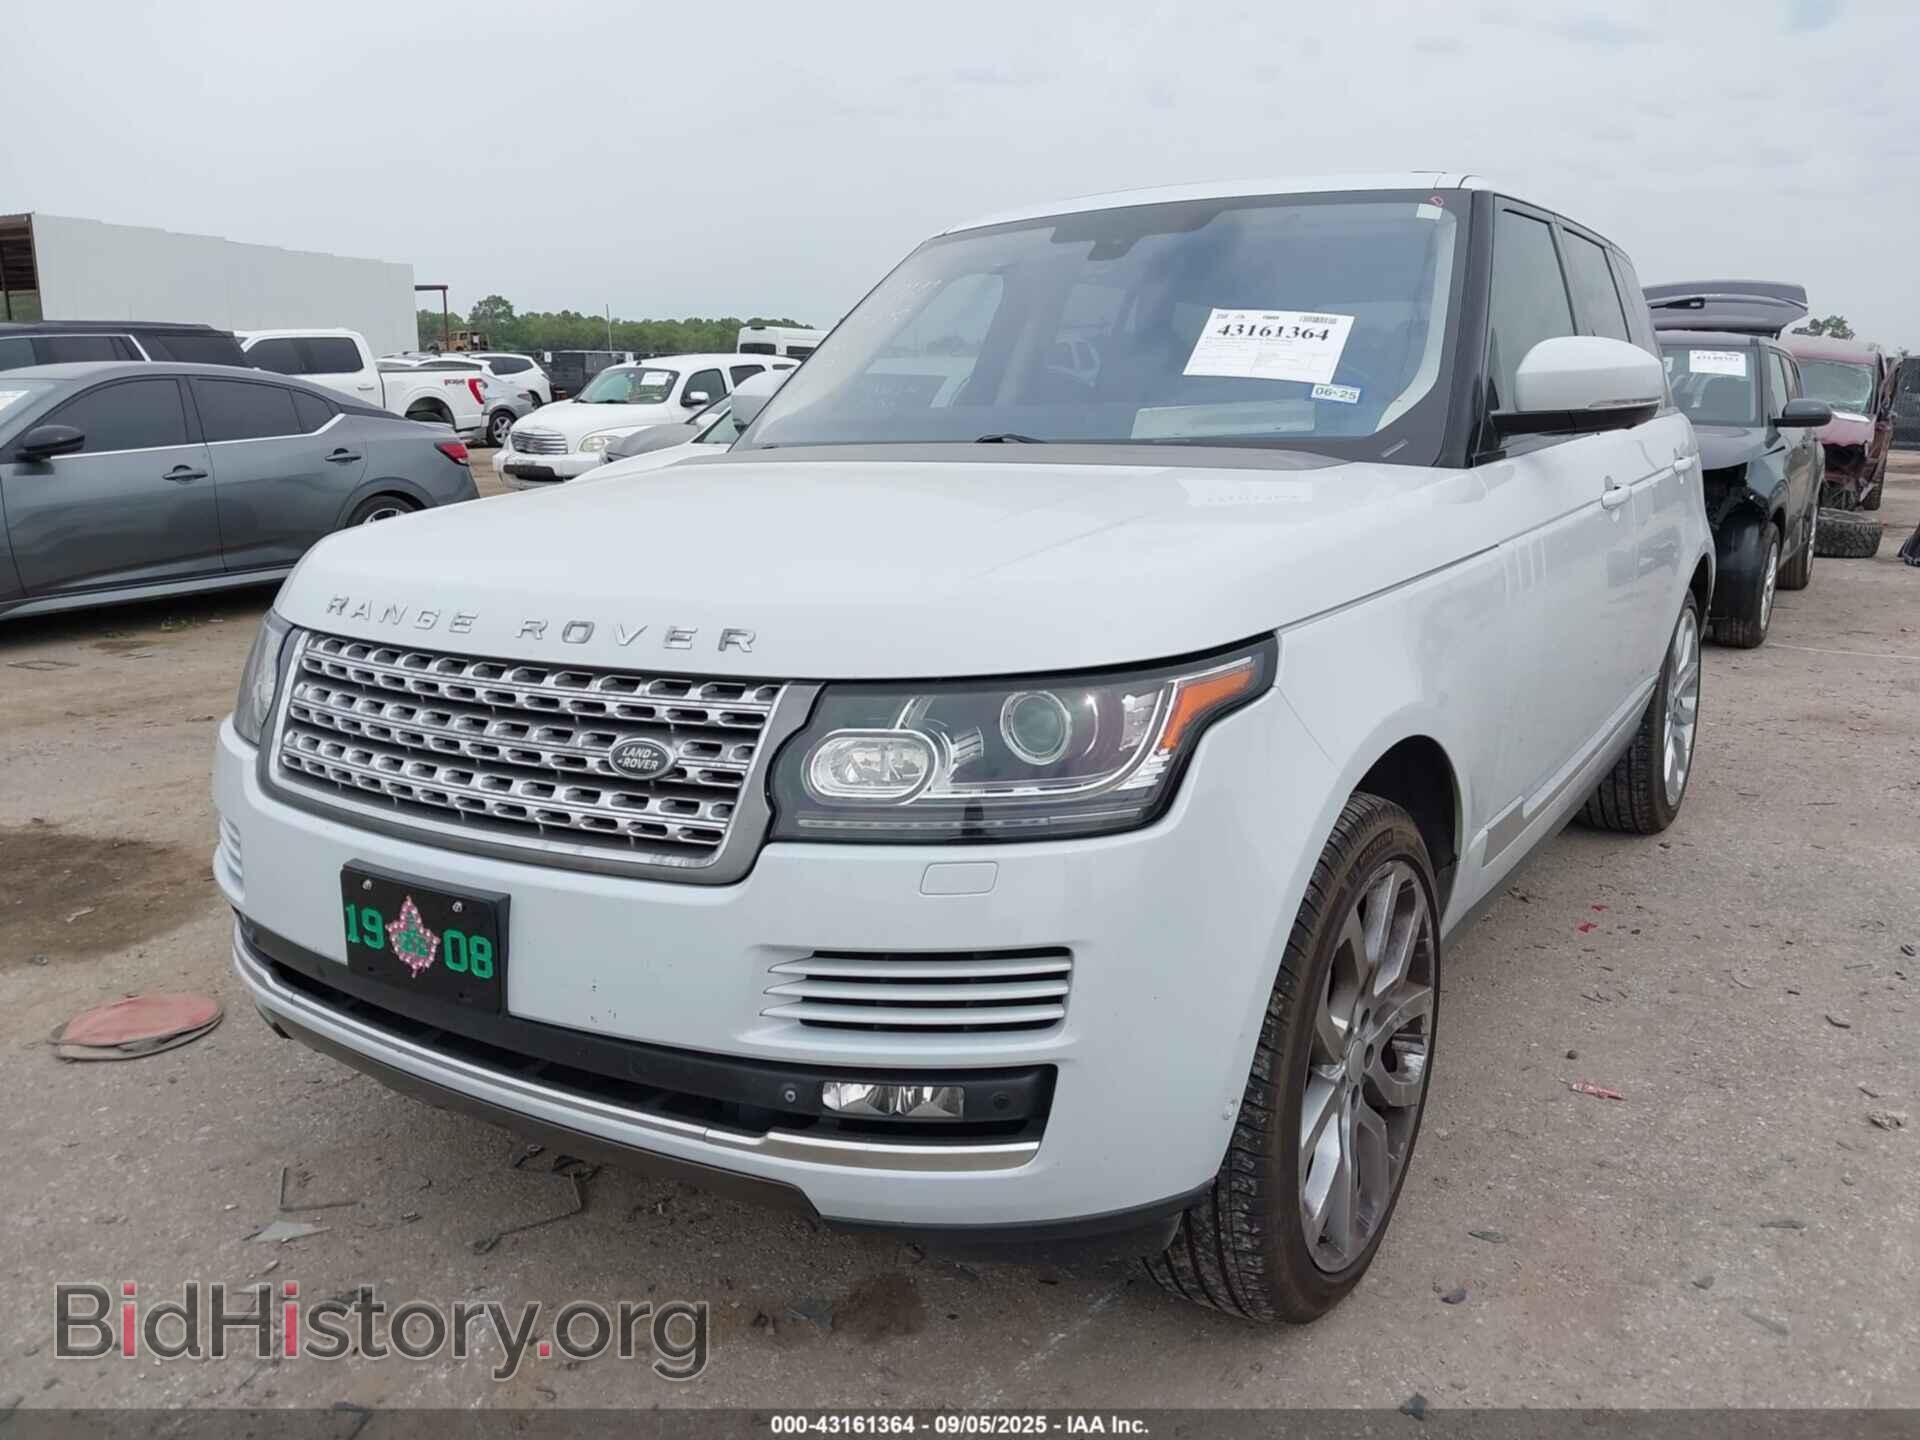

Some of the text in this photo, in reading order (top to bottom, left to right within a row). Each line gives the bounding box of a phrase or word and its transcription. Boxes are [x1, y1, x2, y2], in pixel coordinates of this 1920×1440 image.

[1217, 323, 1330, 341] 43161364
[327, 594, 758, 654] RANGE ROVER
[622, 757, 659, 770] ROVER
[345, 903, 385, 950] 19
[443, 929, 494, 979] 08
